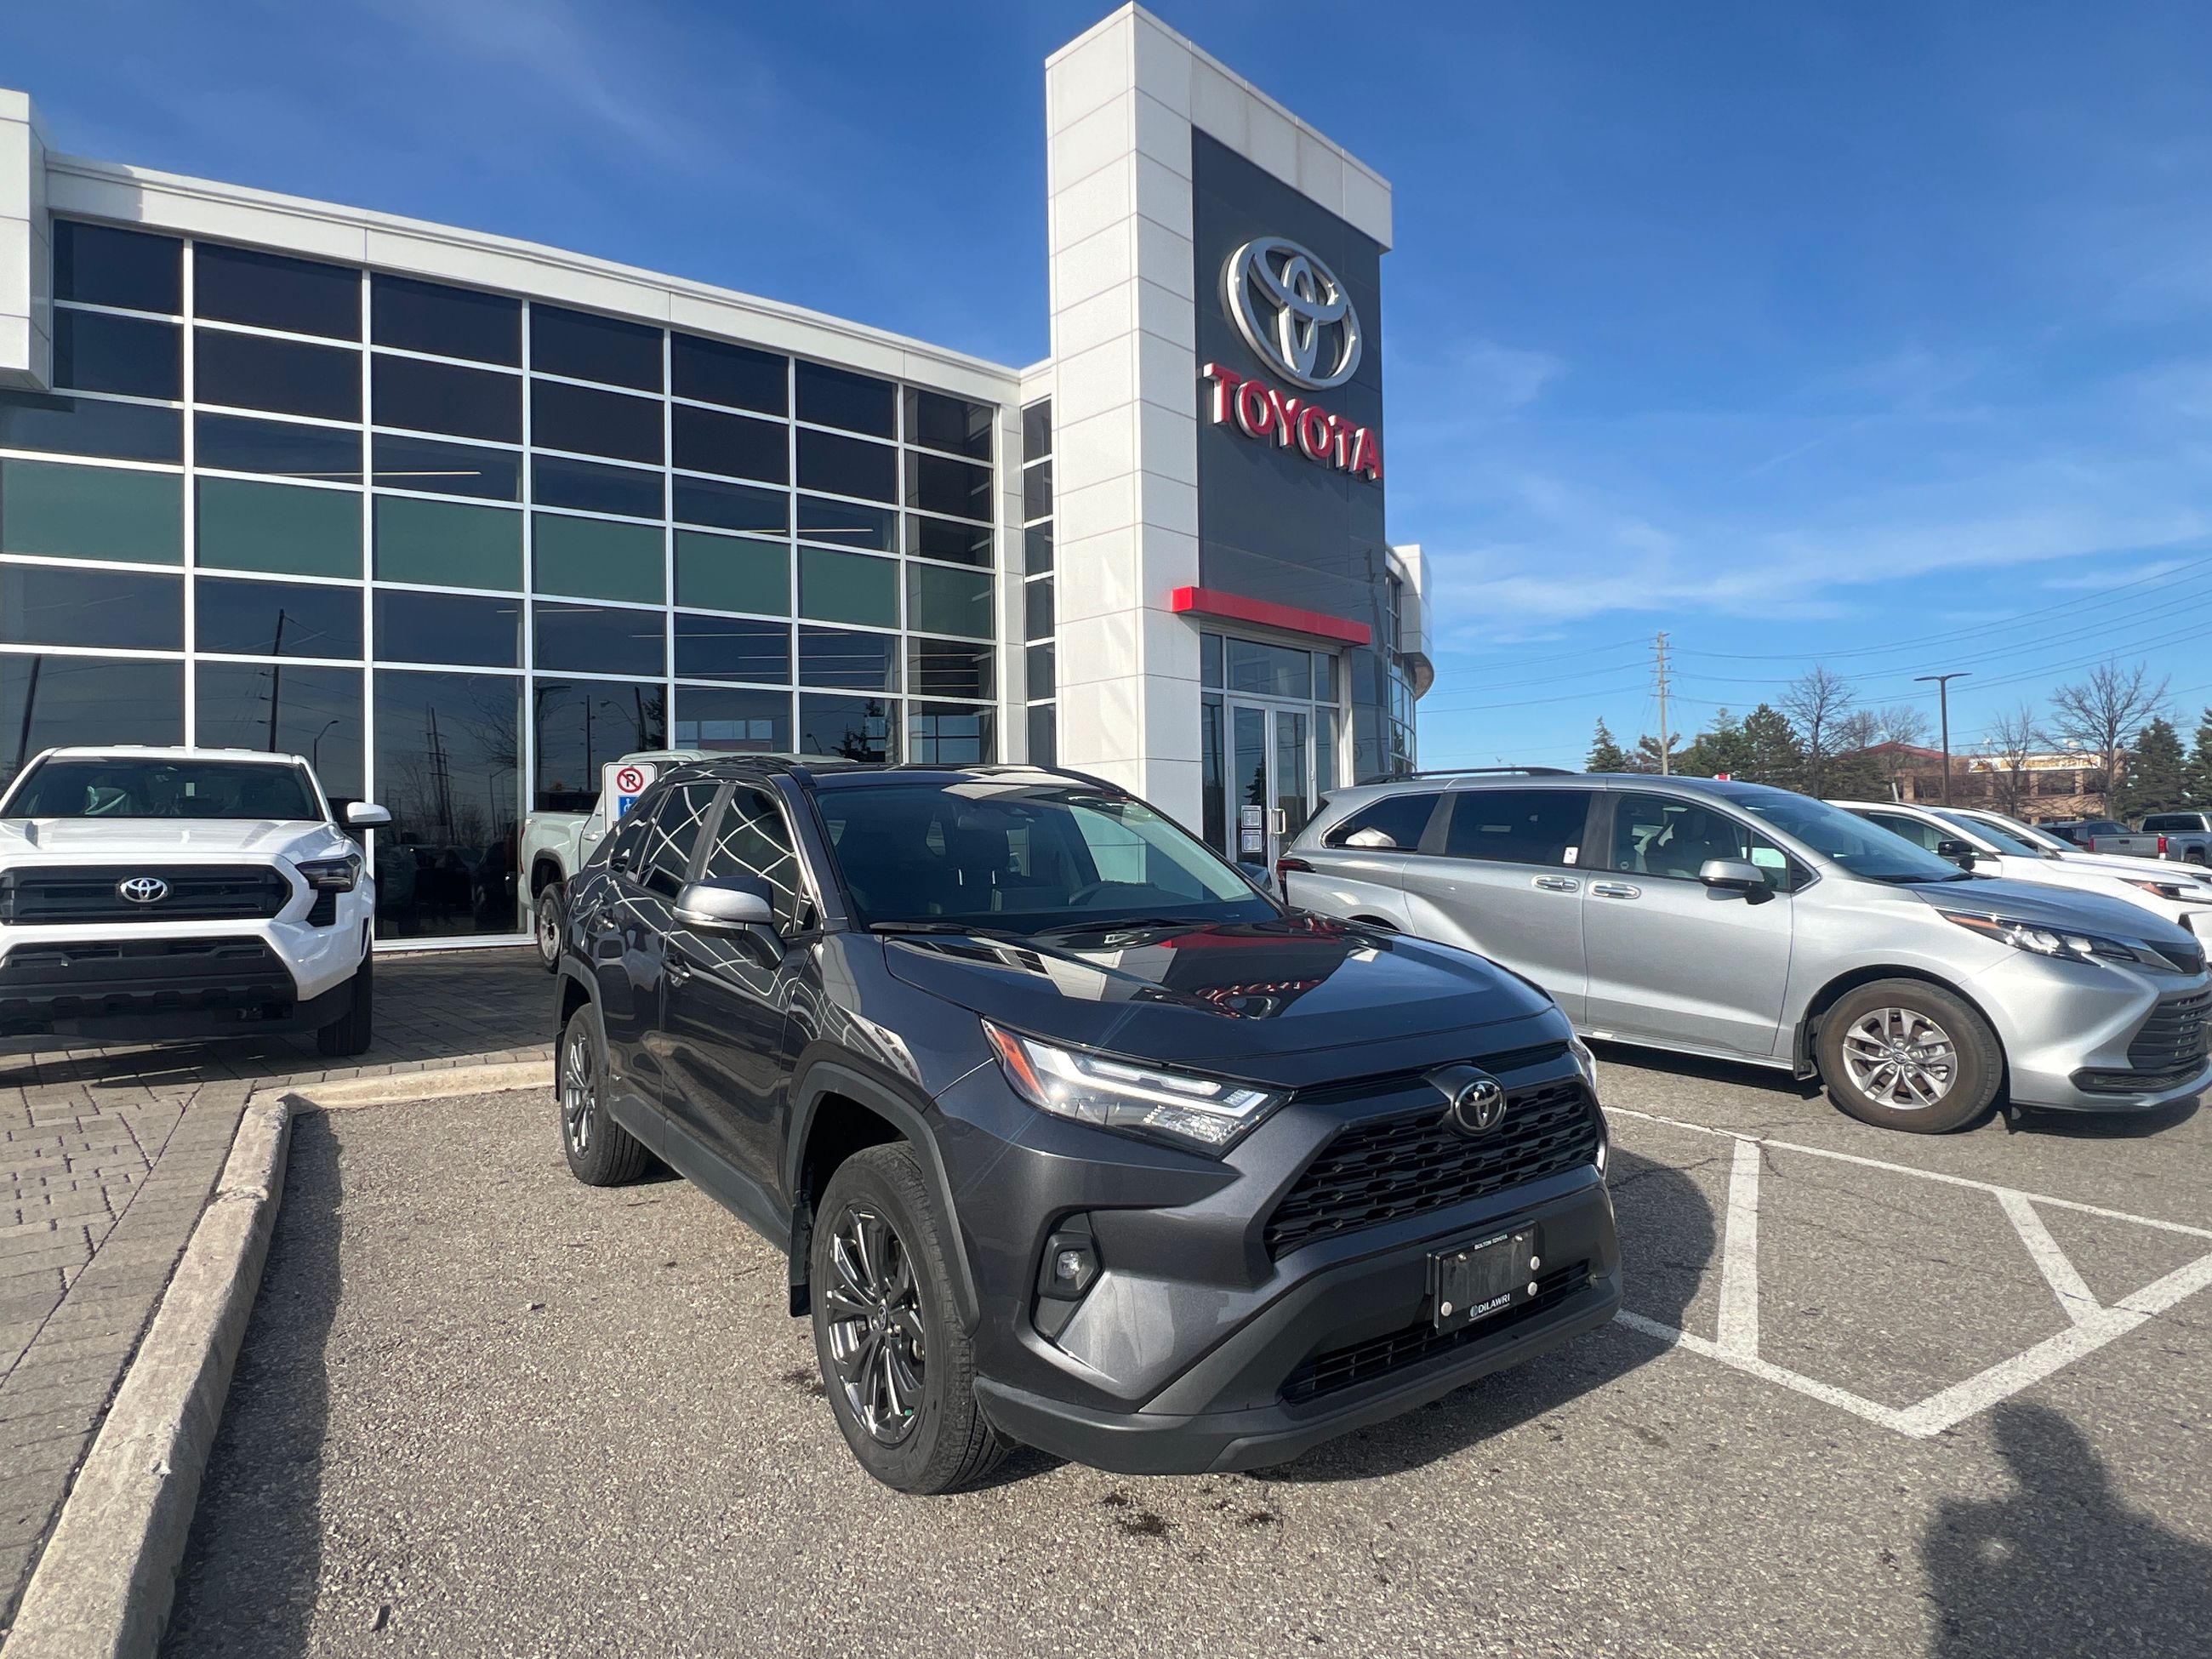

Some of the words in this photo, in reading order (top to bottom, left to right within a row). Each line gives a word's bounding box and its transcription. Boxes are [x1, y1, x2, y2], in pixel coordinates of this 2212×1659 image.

[1203, 362, 1382, 481] TOYOTA
[626, 774, 636, 787] P
[1478, 1292, 1510, 1314] DILAWRI
